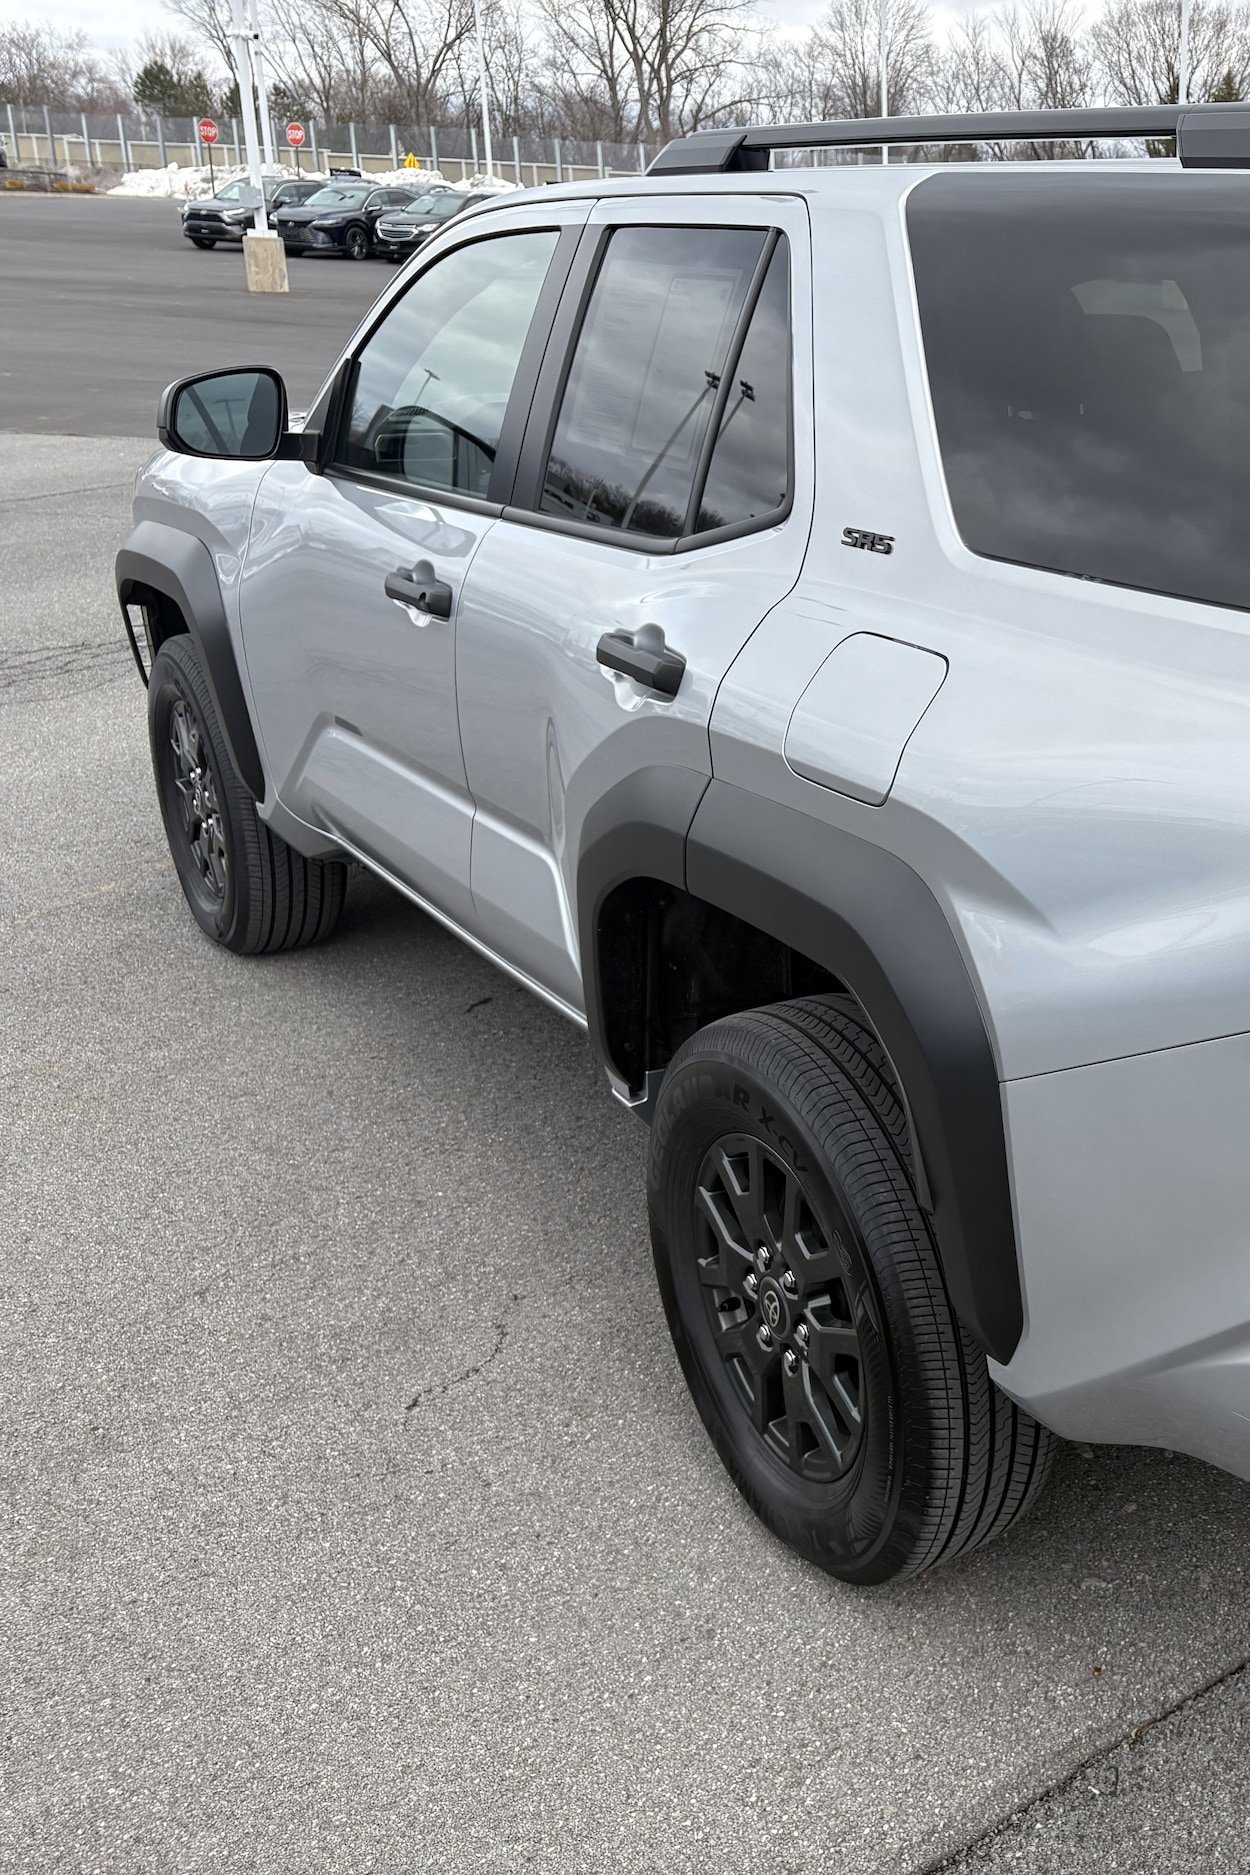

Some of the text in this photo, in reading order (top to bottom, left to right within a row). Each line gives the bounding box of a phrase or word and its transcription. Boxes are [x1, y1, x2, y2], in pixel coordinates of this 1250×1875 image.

[199, 125, 217, 137] STOP
[287, 128, 304, 140] STOP
[841, 527, 896, 555] SR5
